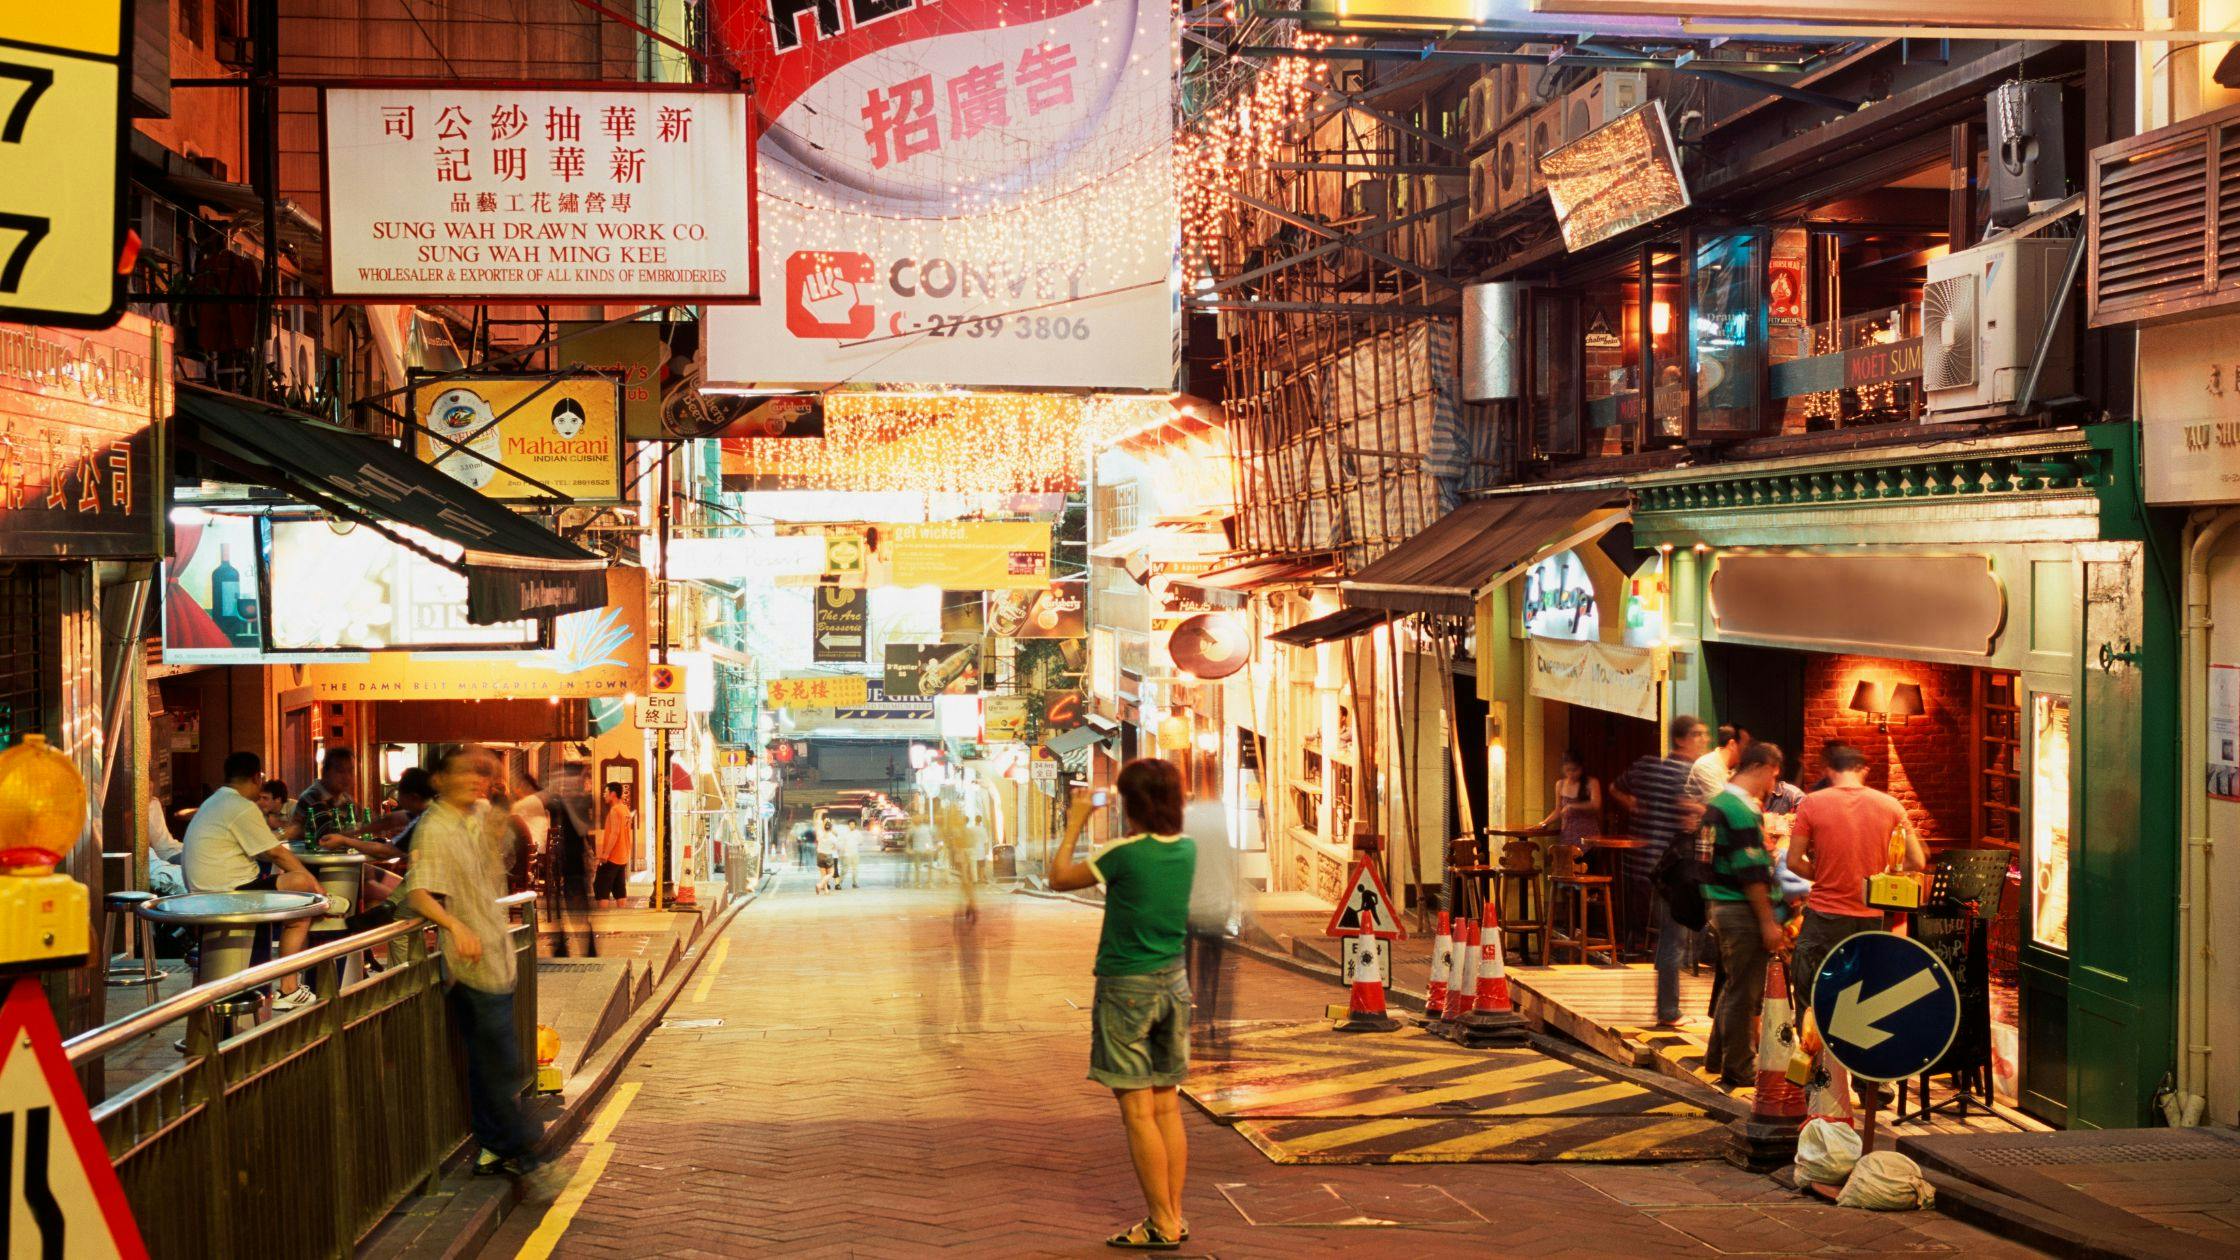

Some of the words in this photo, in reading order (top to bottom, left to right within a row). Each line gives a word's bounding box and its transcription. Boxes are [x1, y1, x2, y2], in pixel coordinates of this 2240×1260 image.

[860, 41, 1077, 170] 招廣告
[372, 222, 436, 241] SUNG
[444, 222, 495, 240] WAH
[504, 222, 588, 241] DRAWN
[595, 222, 666, 241] WORK
[672, 224, 708, 241] CO.
[417, 245, 480, 264] SUNG
[488, 246, 540, 263] WAH
[549, 246, 611, 264] MING
[620, 247, 667, 263] KEE
[358, 267, 443, 283] WHOLESALER
[446, 268, 456, 282] &
[460, 268, 524, 282] EXPORTER
[526, 268, 543, 282] OF
[547, 268, 571, 282] ALL
[575, 269, 615, 282] KINDS
[618, 269, 635, 283] OF
[638, 269, 727, 284] EMBROIDERIES
[889, 258, 1088, 300] CONVEY
[927, 313, 1004, 338] 2739
[1014, 317, 1090, 341] 3806
[1890, 346, 1923, 375] SUM
[768, 398, 812, 413] Carlsberg
[508, 437, 608, 455] Maharani
[819, 609, 837, 620] The
[818, 622, 862, 632] Brasserie
[321, 682, 347, 692] THE
[359, 681, 401, 691] DAMN
[458, 680, 548, 690] MARGARITA
[585, 680, 628, 689] TOWN
[649, 696, 675, 706] End
[645, 709, 677, 724] 終止
